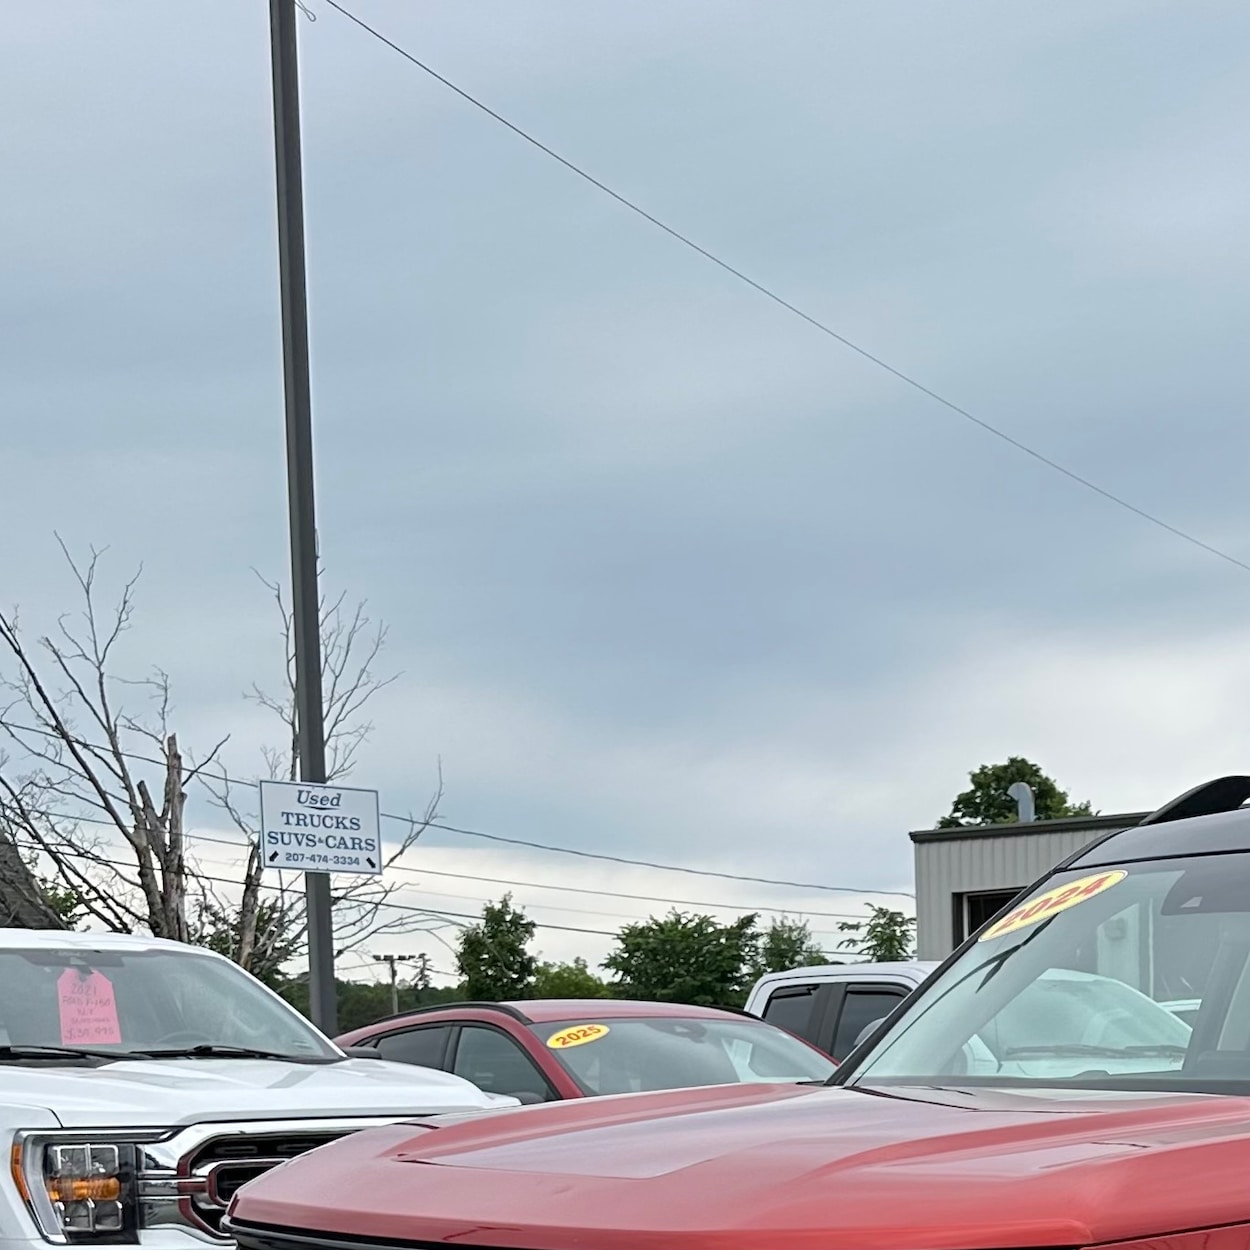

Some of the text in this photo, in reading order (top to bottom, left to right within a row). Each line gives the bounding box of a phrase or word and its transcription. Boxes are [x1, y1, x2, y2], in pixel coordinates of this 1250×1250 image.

[297, 790, 342, 807] Used
[281, 811, 361, 831] TRUCKS
[285, 852, 360, 866] 207-474-3334
[991, 874, 1113, 937] 2024
[555, 1025, 602, 1046] 2025
